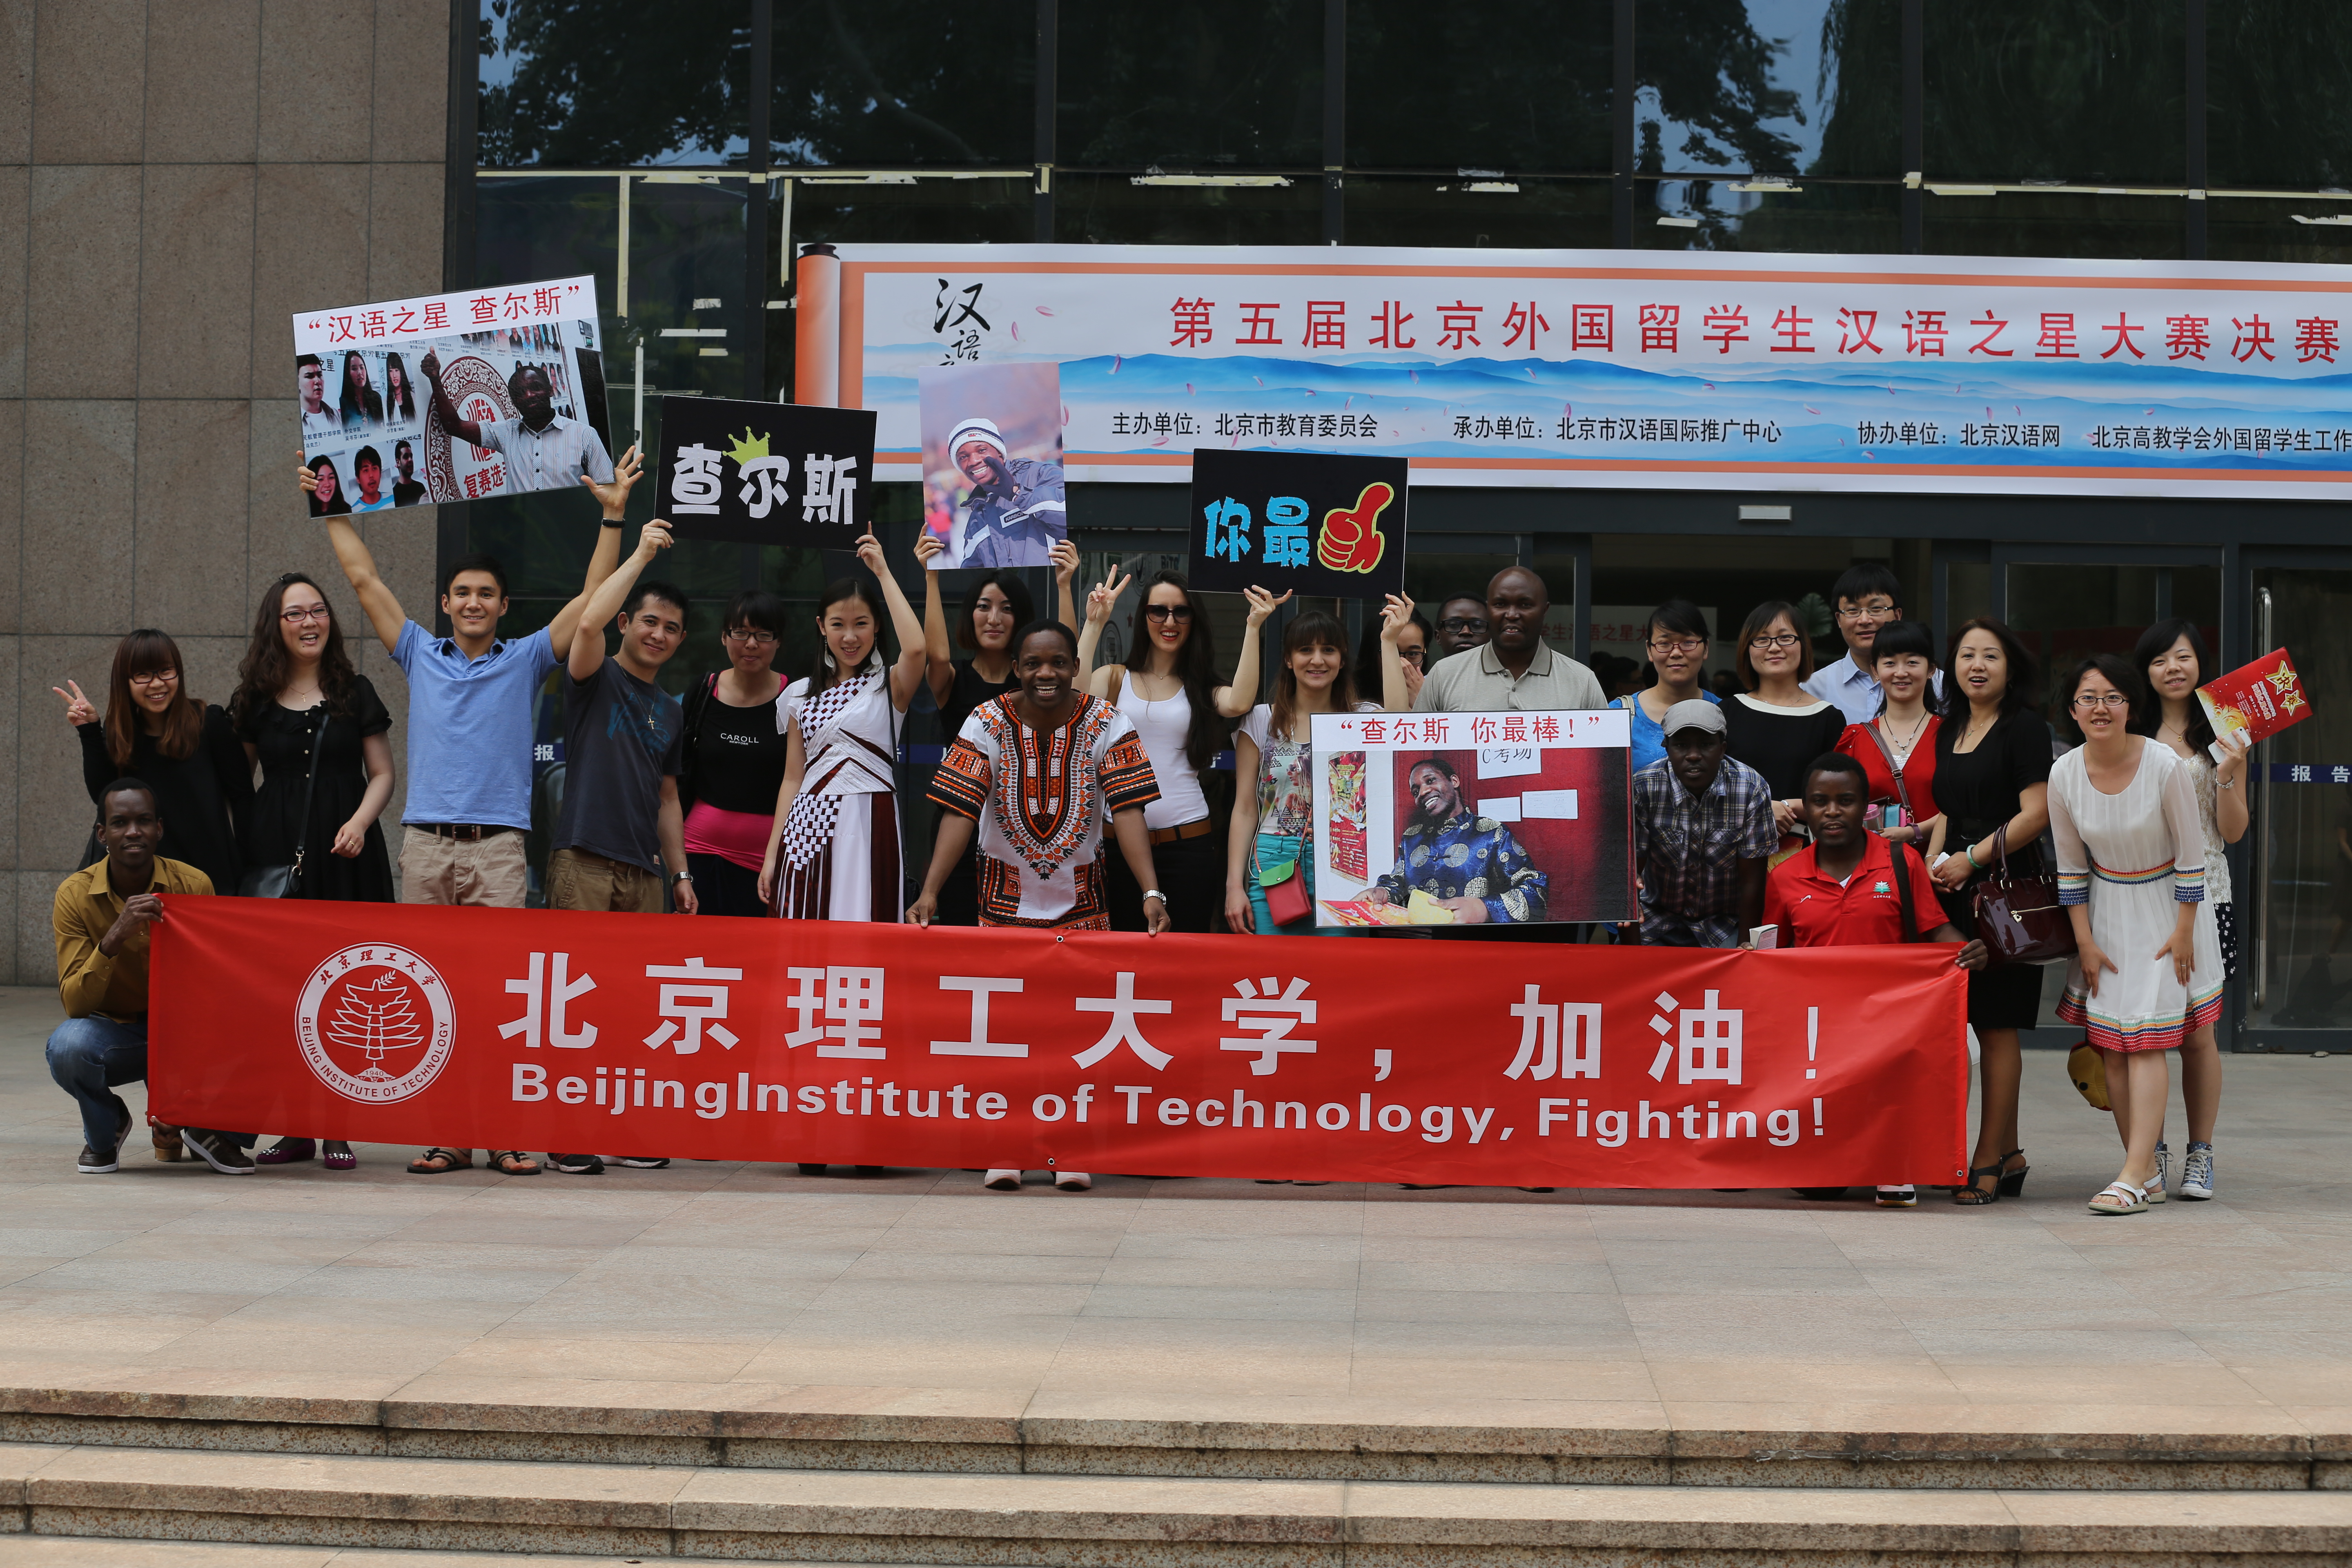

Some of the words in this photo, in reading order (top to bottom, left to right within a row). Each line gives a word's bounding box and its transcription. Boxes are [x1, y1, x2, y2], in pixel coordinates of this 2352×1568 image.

[309, 302, 451, 343] “汉语之星
[470, 285, 579, 324] 查尔斯”
[1170, 297, 2340, 364] 第五届北京外国留学生汉语之星大赛决赛
[1112, 412, 1378, 438] 主办单位：北京市教育委员会
[1453, 416, 1782, 443] 承办单位：北京市汉语国际推广中心
[1858, 421, 2060, 448] 协办单位：北京汉语网
[2092, 425, 2352, 452] 北京高教学会外国留学生工作
[671, 443, 857, 525] 查尔斯
[1204, 496, 1310, 568] 你最
[720, 733, 759, 743] CAROLL
[1341, 717, 1450, 745] “查尔斯
[320, 949, 437, 986] 北京理工大学
[302, 1017, 322, 1063] BEIJING
[320, 1064, 378, 1097] INSTITUTE
[383, 1085, 399, 1097] OF
[401, 1021, 449, 1091] TECHNOLOGY
[1031, 1084, 1095, 1123] of
[1114, 1085, 1515, 1144] Technology,
[1538, 1097, 1825, 1147] Fighting!
